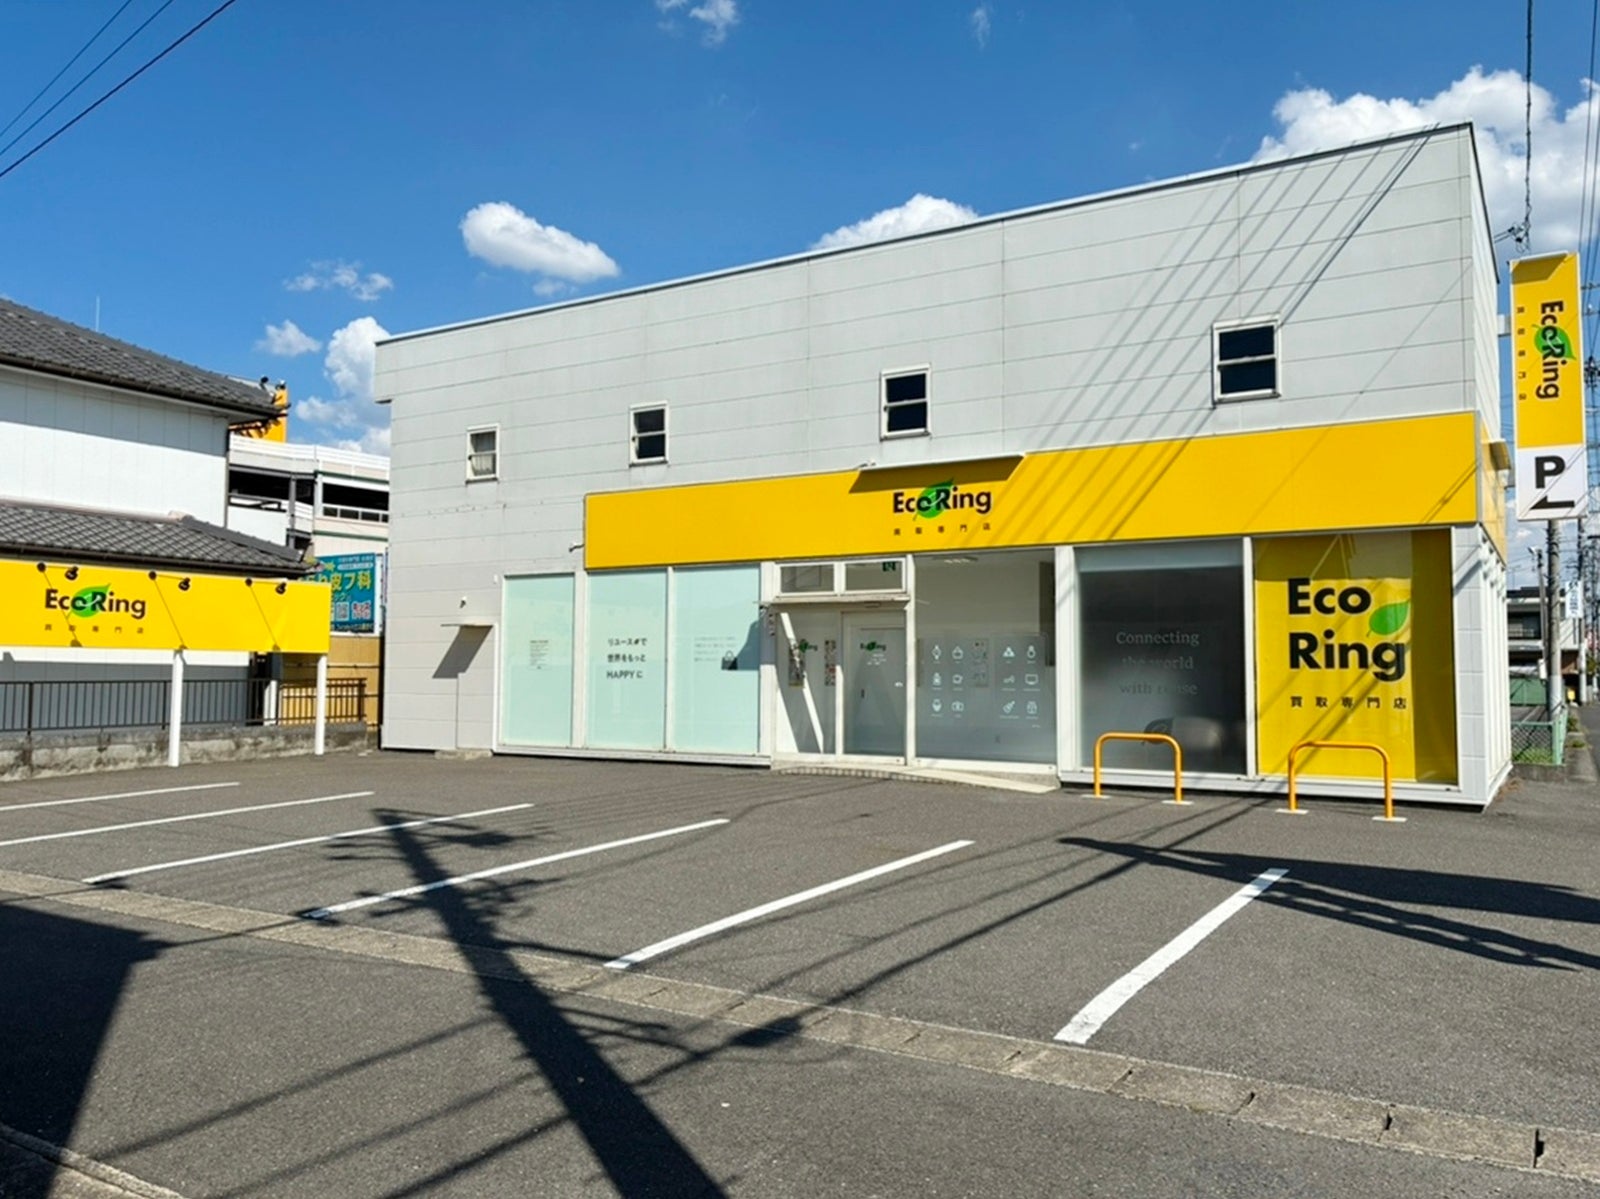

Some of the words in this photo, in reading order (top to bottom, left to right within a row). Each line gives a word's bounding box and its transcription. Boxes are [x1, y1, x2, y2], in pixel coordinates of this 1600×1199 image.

[1535, 455, 1566, 489] P
[1288, 578, 1372, 615] Eco
[1116, 631, 1200, 647] Connecting
[1289, 629, 1406, 682] Ring
[1120, 683, 1152, 695] with
[1157, 684, 1198, 695] rese
[1290, 696, 1406, 709] 買取専門店
